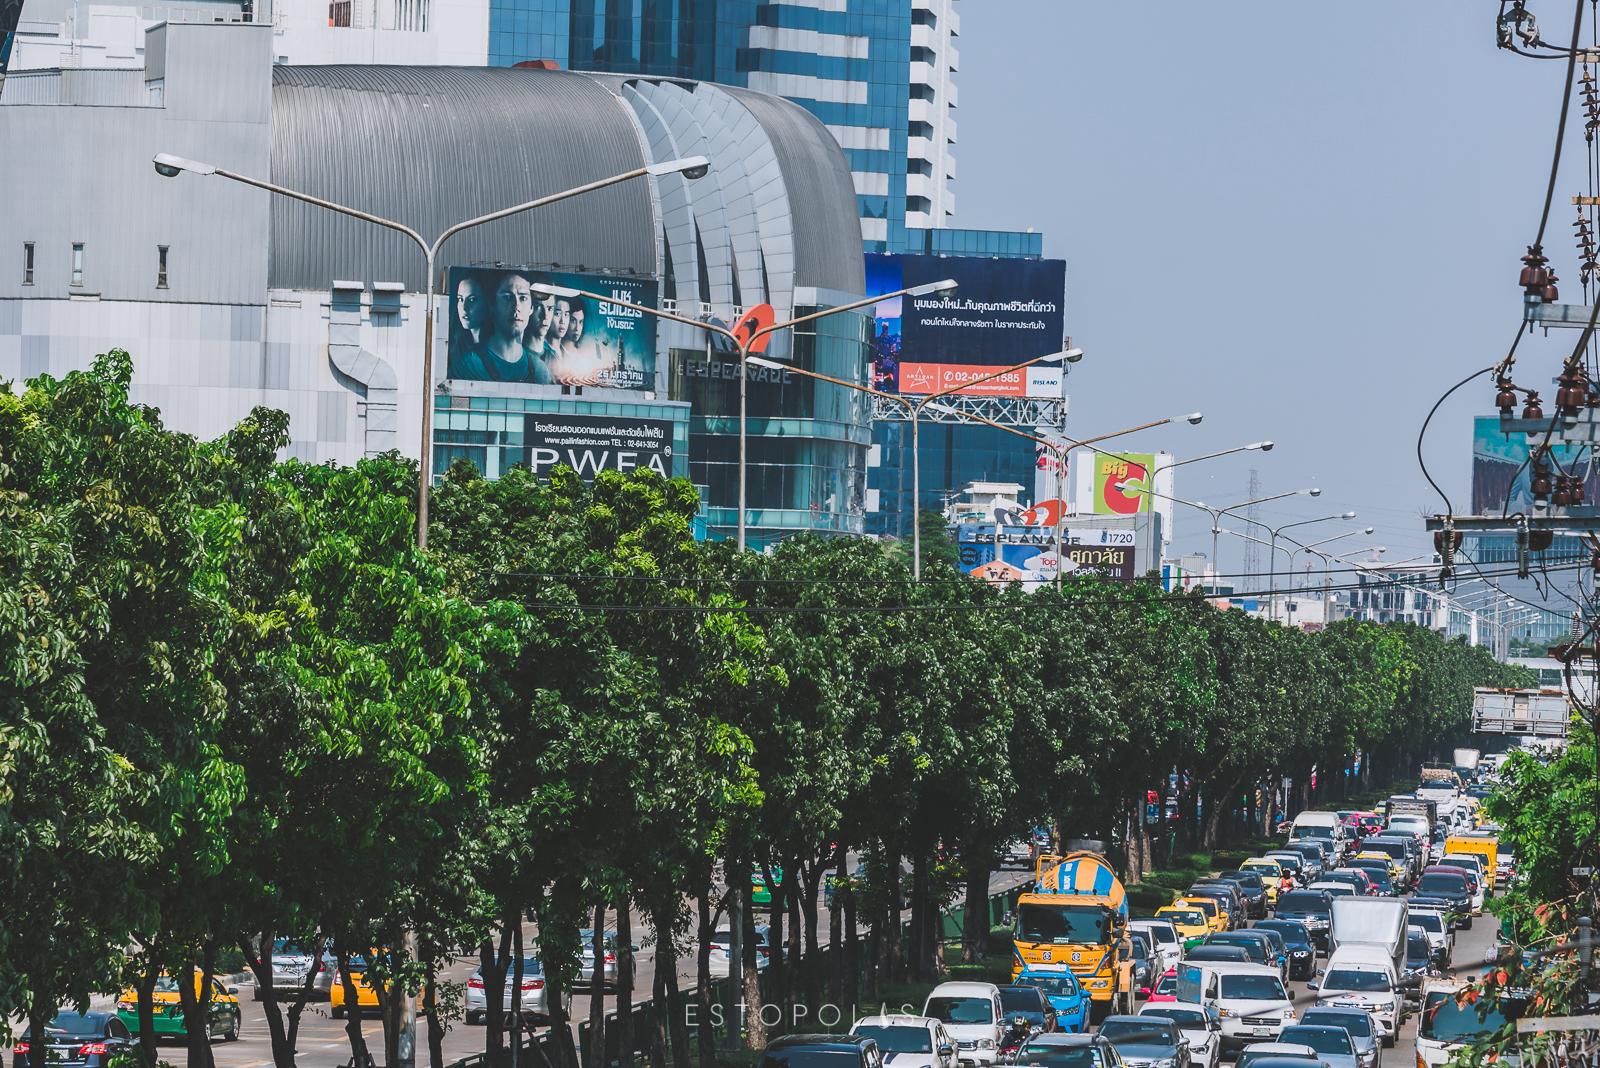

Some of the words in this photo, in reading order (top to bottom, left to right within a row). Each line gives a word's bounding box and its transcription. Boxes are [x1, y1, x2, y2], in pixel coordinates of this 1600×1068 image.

[611, 438, 622, 447] TEL
[1102, 461, 1128, 480] Big
[1108, 533, 1133, 544] 1720
